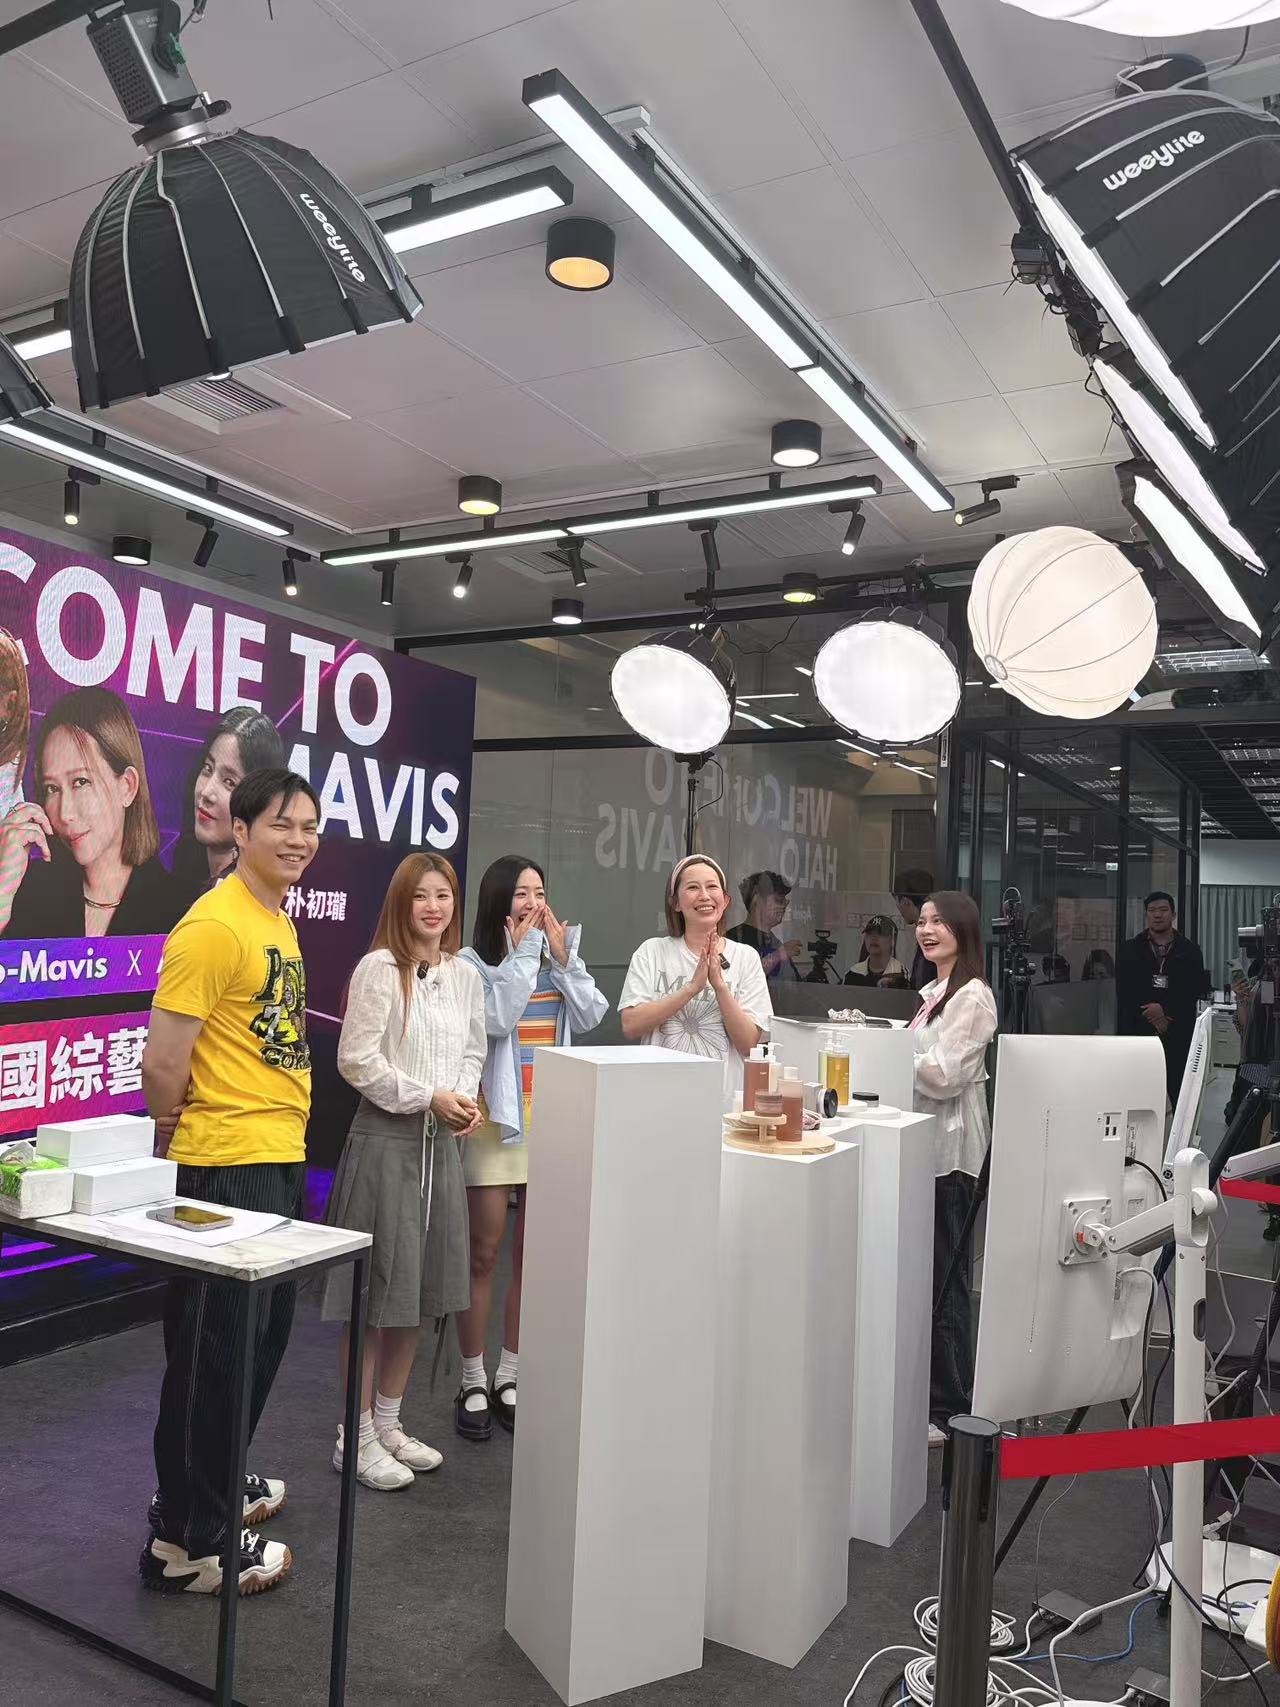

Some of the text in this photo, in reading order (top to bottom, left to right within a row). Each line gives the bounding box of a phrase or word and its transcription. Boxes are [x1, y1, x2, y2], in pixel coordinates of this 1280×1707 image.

[1102, 131, 1205, 191] weeylite
[299, 193, 366, 283] weeylite
[290, 632, 392, 747] TO
[285, 885, 347, 922] 朴初瓏
